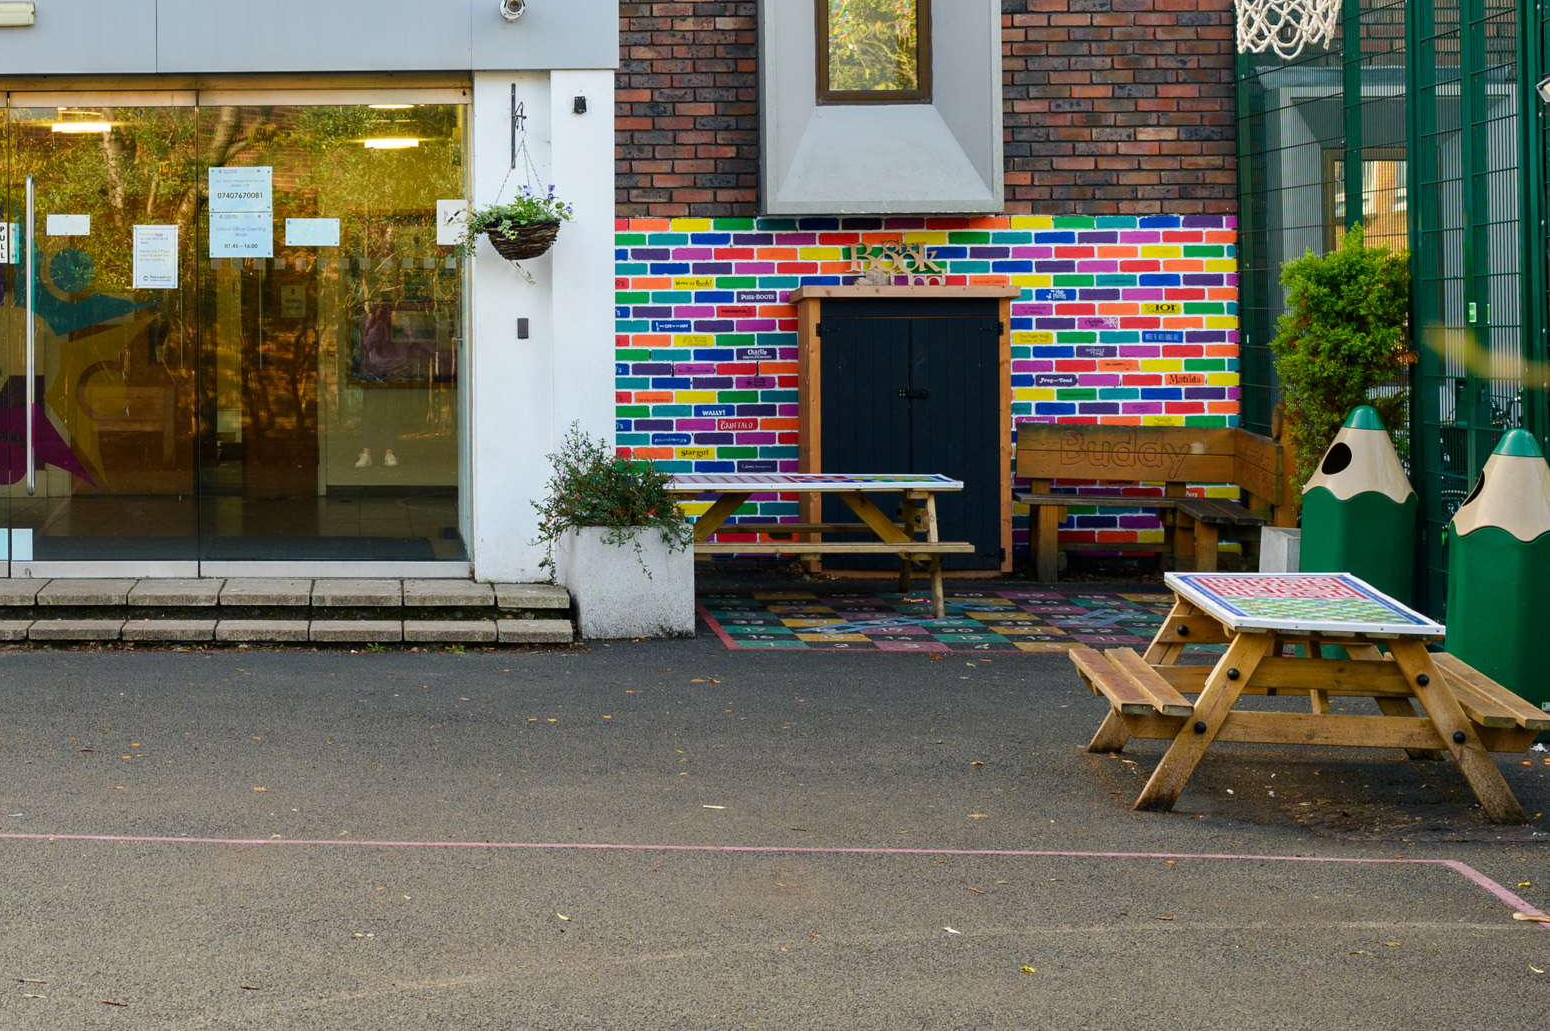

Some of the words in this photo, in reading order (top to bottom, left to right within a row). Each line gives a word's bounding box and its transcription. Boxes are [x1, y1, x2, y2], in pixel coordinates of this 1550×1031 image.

[1169, 374, 1201, 384] Matilda
[702, 409, 726, 417] WALLY?
[681, 449, 709, 458] Stargirl
[1059, 429, 1191, 480] Buddy
